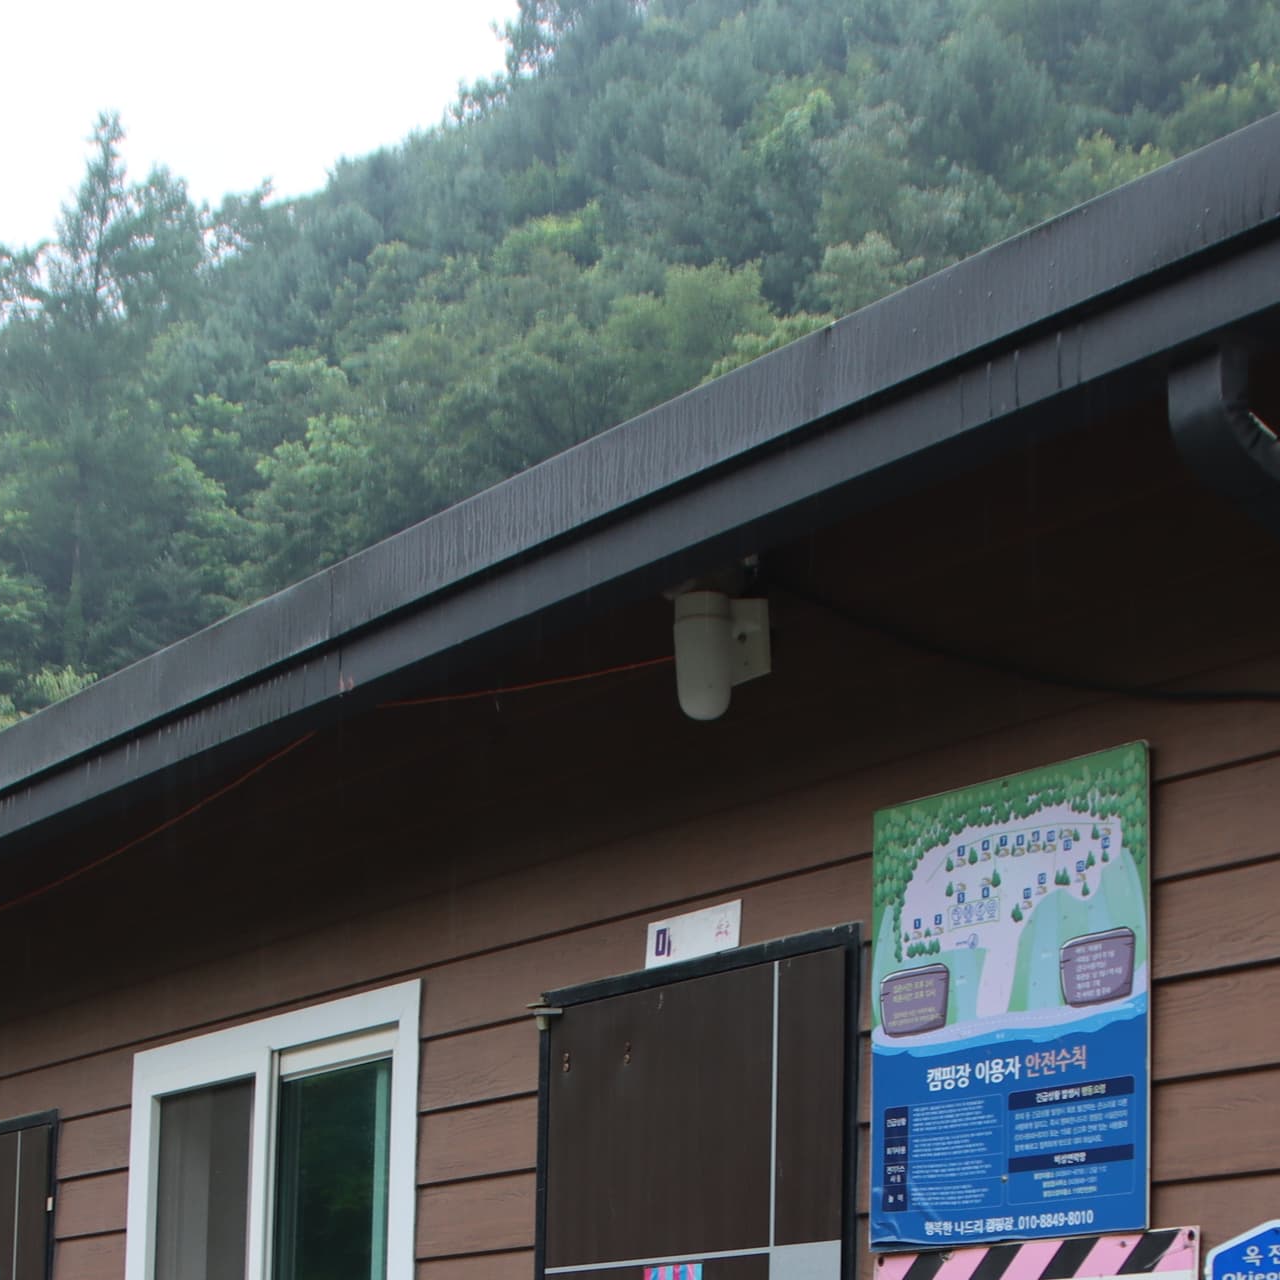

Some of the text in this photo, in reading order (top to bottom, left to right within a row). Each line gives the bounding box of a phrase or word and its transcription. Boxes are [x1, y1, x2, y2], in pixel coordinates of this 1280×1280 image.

[926, 1045, 1087, 1092] 캠핑장 이용자 안전수칙
[924, 1221, 952, 1236] 행복한
[954, 1219, 983, 1235] 나드리
[1018, 1209, 1094, 1230] 010-8849-8010
